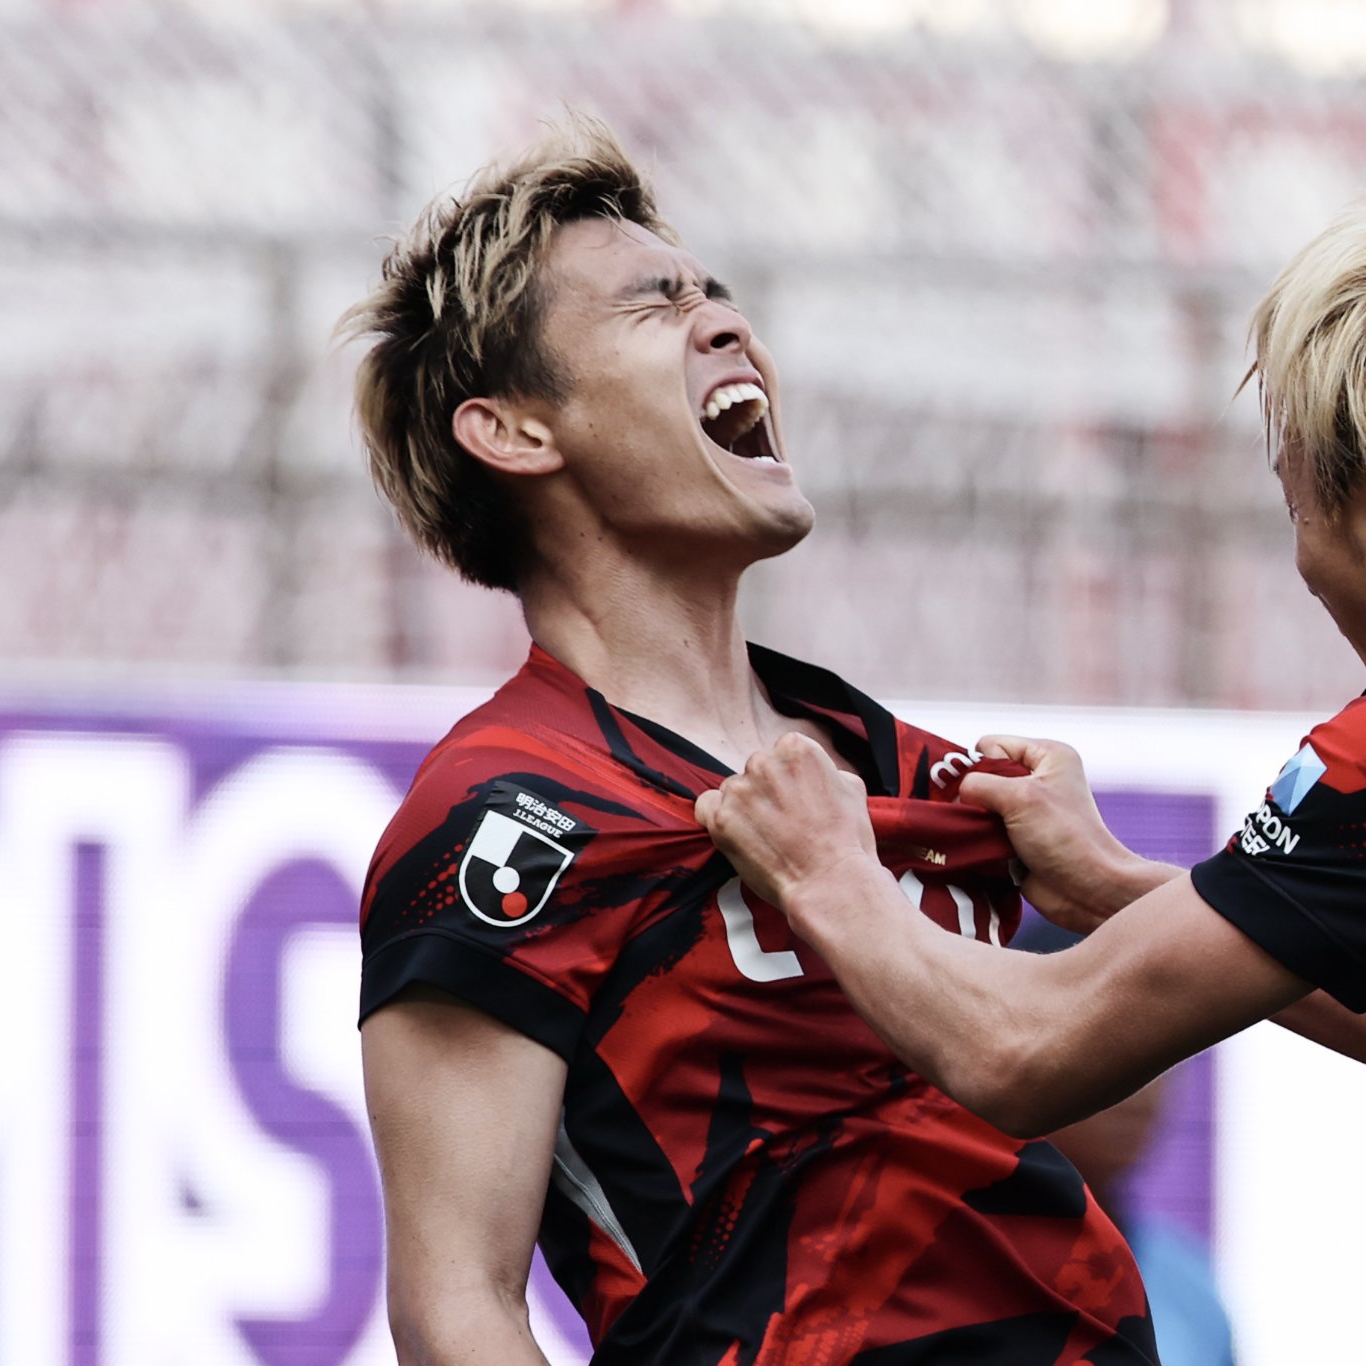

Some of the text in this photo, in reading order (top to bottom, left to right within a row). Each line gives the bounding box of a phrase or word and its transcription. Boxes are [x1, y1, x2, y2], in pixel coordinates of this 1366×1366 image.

[515, 792, 576, 831] 明治安田
[1256, 802, 1301, 855] PON
